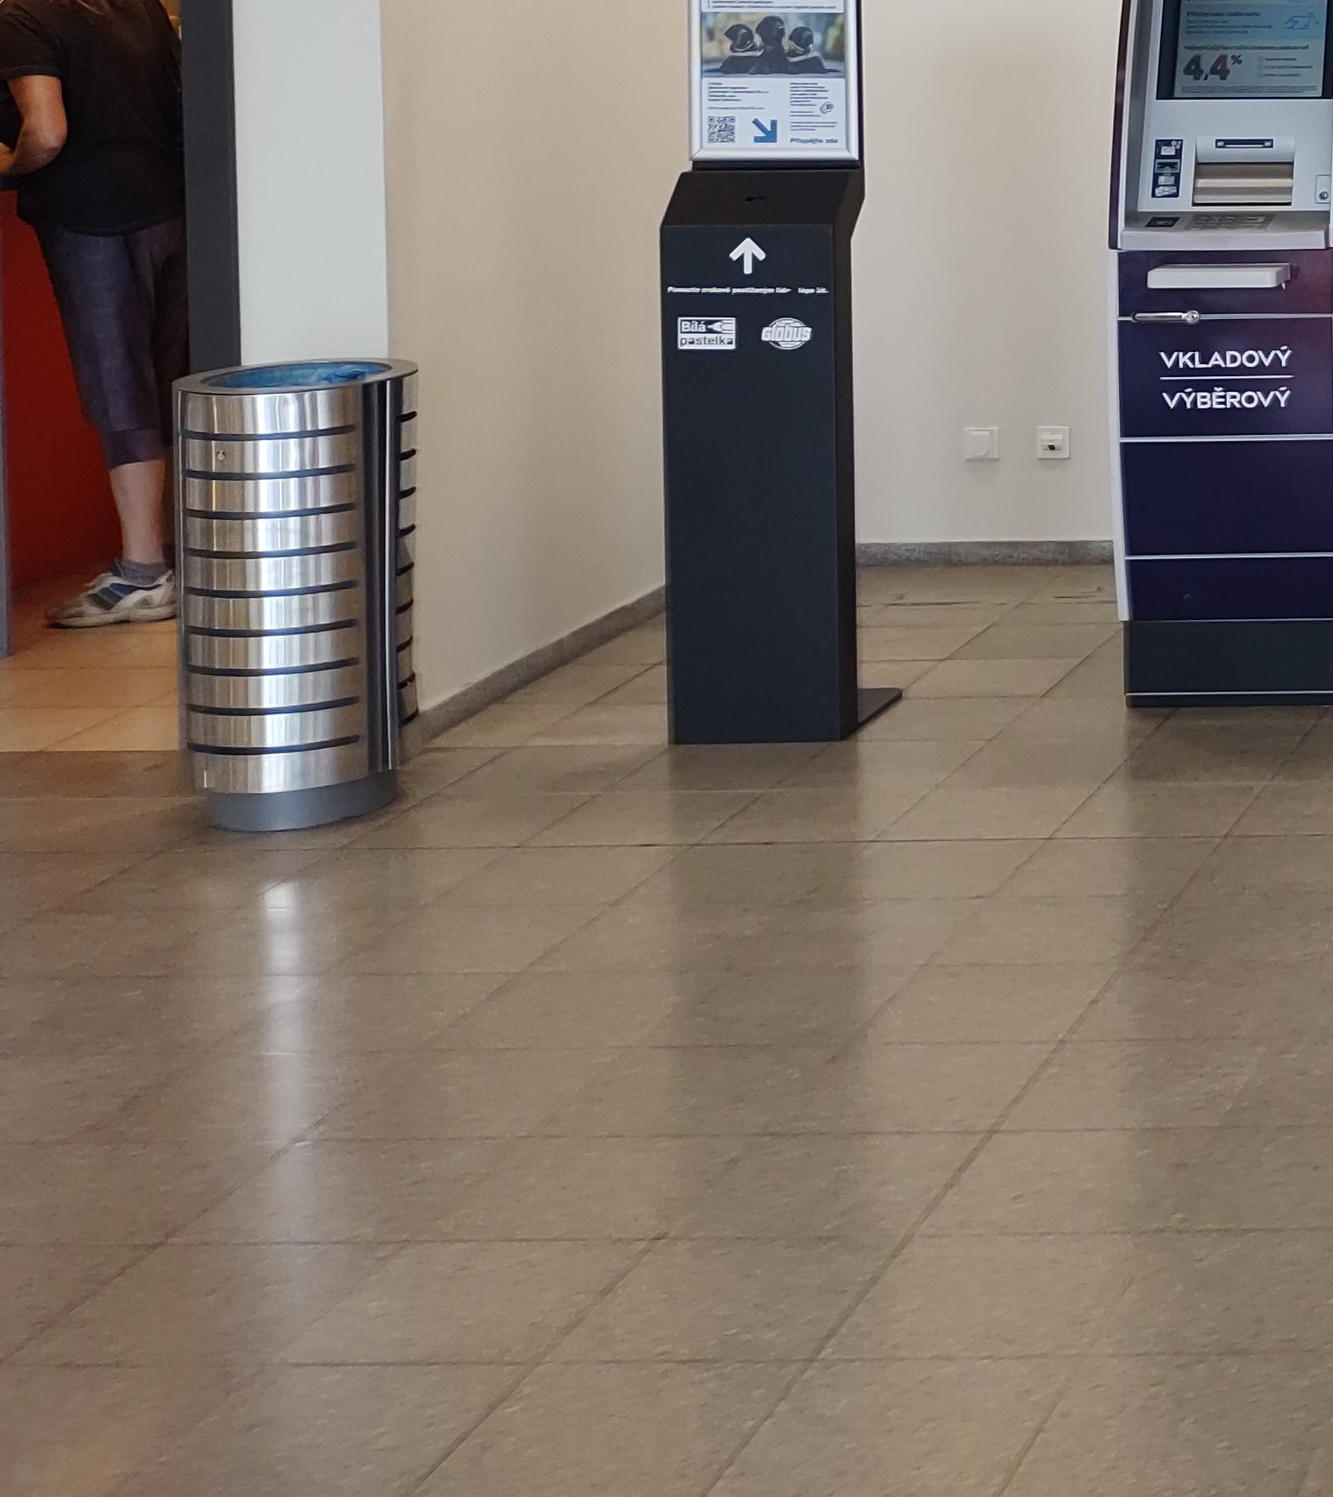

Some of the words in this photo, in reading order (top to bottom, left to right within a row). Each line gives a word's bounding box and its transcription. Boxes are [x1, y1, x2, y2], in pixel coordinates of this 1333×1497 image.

[681, 320, 706, 333] Bílá
[680, 335, 734, 346] pastelka
[1160, 346, 1292, 369] VKLADOVÝ
[1162, 387, 1291, 409] VÝBĚROVÝ
